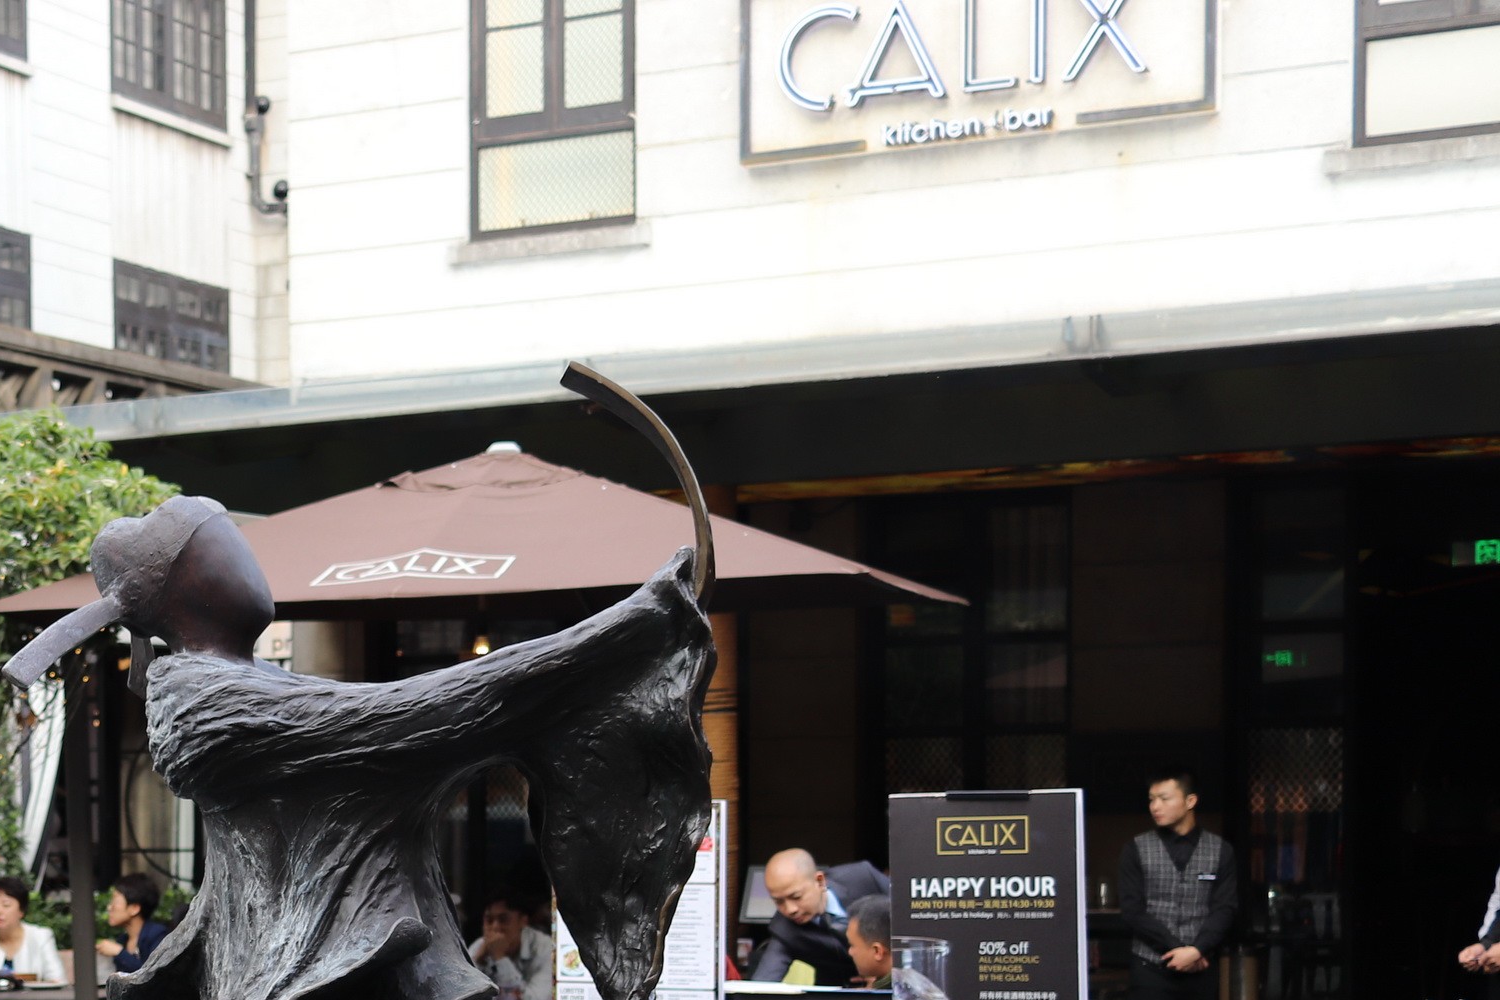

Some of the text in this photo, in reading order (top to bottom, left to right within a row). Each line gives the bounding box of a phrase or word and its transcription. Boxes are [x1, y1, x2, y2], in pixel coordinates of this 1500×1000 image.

[773, 0, 1148, 111] CALIX
[881, 106, 1054, 147] kitchen bar
[334, 553, 486, 581] CALIX
[944, 822, 1018, 847] CALIX
[910, 875, 1057, 899] HAPPY HOUR
[911, 900, 931, 910] MON
[932, 900, 943, 909] TO
[944, 900, 957, 909] FRI
[910, 911, 939, 920] excluding
[969, 911, 994, 919] holidays
[979, 941, 1029, 955] 50% off
[979, 956, 1040, 964] ALL ALCOHOLIC
[979, 965, 1022, 973] BEVERAGES
[979, 974, 1030, 982] BY THE GLASS
